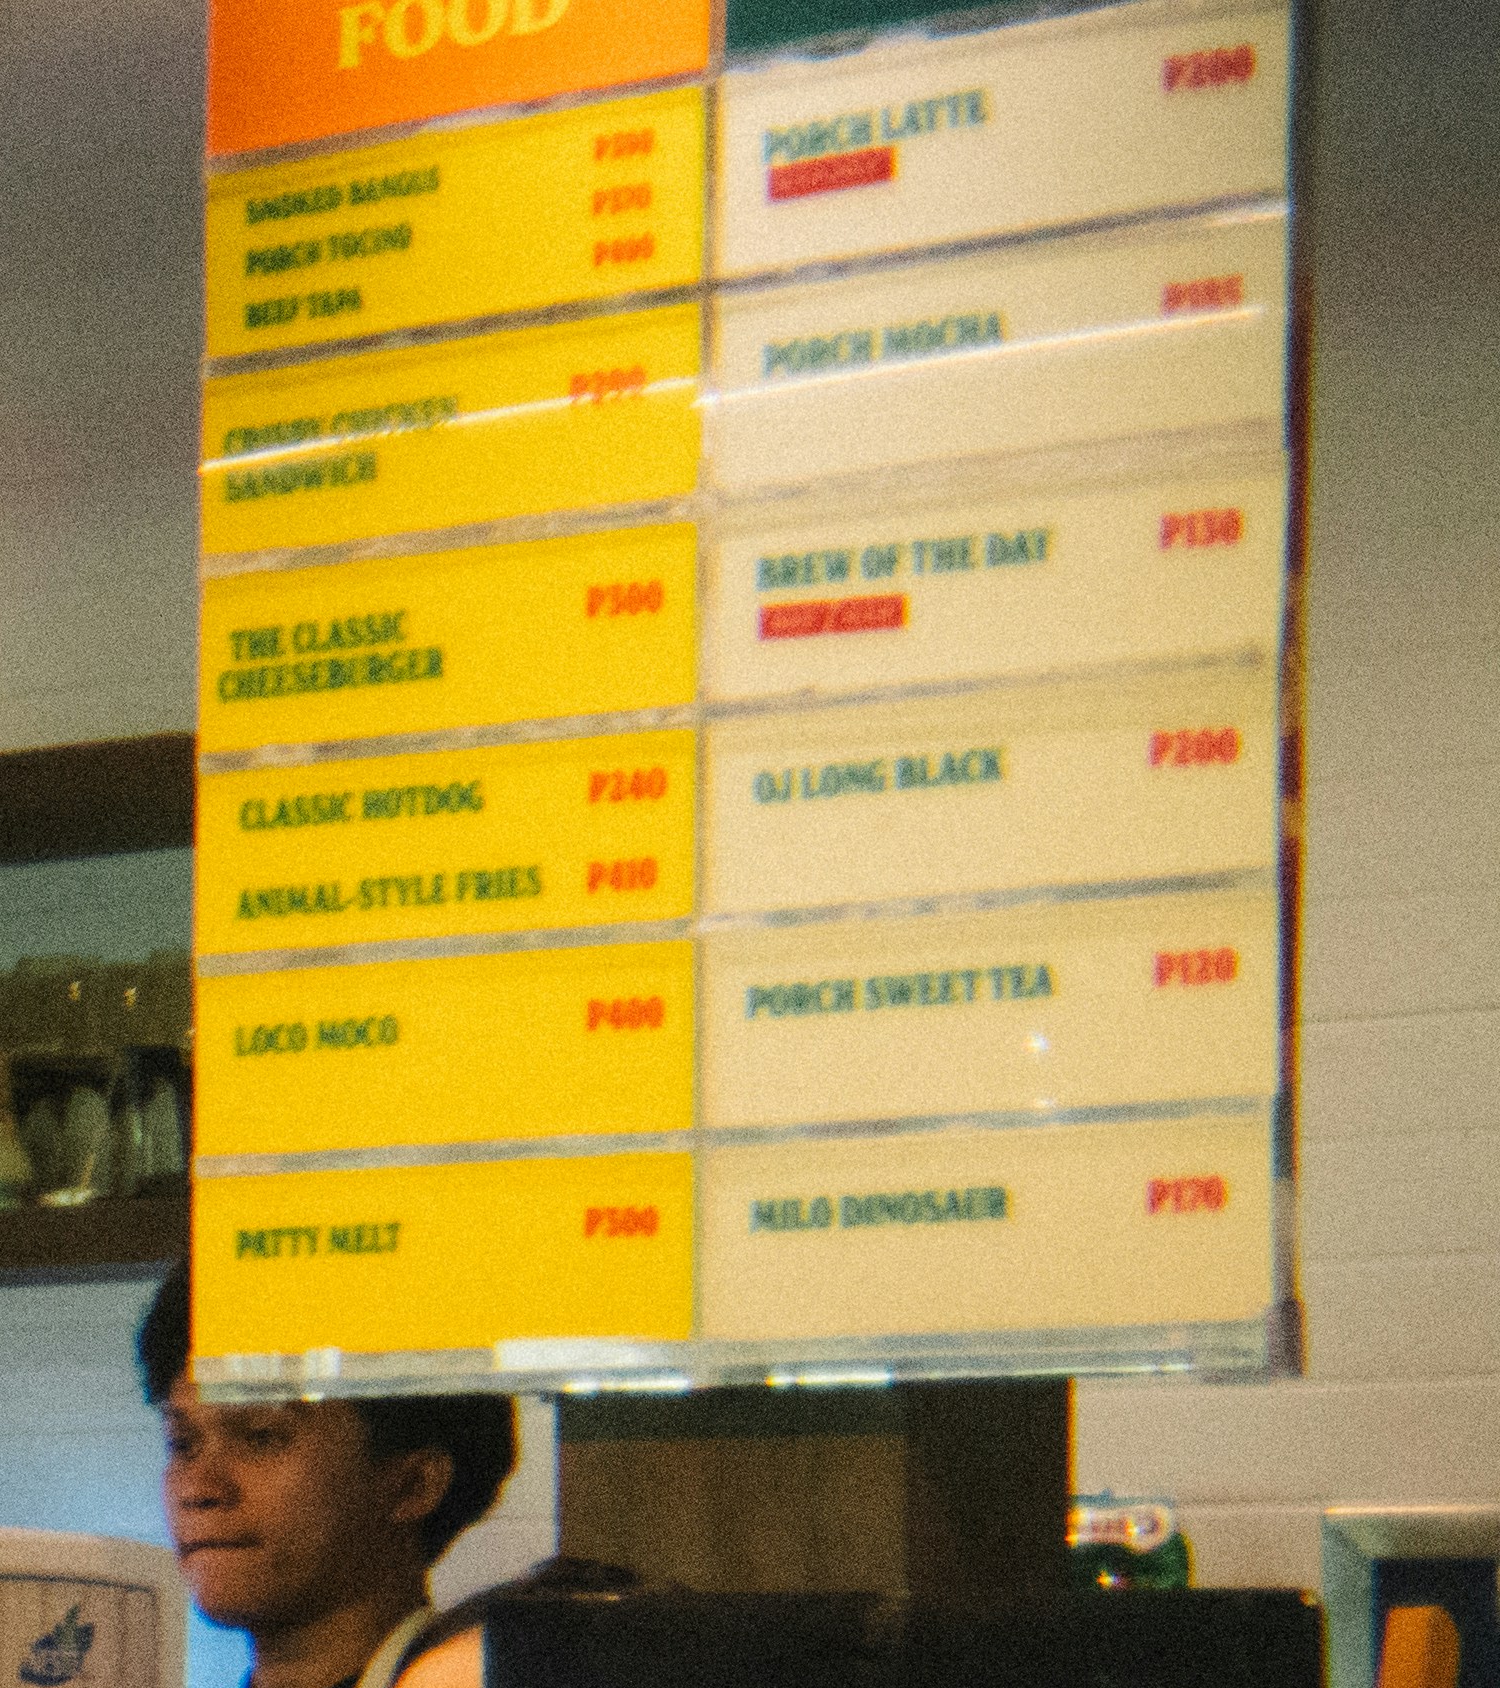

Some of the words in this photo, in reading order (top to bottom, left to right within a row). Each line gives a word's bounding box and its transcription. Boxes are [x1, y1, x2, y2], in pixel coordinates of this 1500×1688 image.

[338, 0, 570, 69] FOOD
[883, 92, 986, 138] LATTE
[764, 336, 871, 376] PORCH
[886, 315, 1002, 360] MOCHA
[758, 552, 849, 590] BREW
[864, 545, 897, 578] OF
[913, 538, 977, 572] THE
[987, 531, 1050, 566] DAY
[231, 628, 283, 659] THE
[293, 612, 406, 650] CLASSIC
[217, 649, 442, 701] CHEESEBURGER
[754, 772, 790, 802] OJ
[802, 761, 884, 797] LONG
[898, 750, 1001, 789] BLACK
[1150, 730, 1239, 767] P200
[241, 794, 351, 829] CLASSIC
[362, 783, 483, 820] HOTDOG
[236, 874, 445, 919] ANIMAL-STYLE
[457, 867, 542, 899] FRIES
[747, 986, 853, 1018] PORCH
[866, 972, 978, 1008] SWEET
[990, 967, 1053, 1000] TEA
[1155, 951, 1237, 985] P120
[235, 1024, 306, 1055] LOCO
[317, 1017, 399, 1048] MOCO
[752, 1198, 831, 1231] MILO
[842, 1188, 1007, 1227] DINOSAUR
[236, 1228, 319, 1259] PATTY
[329, 1223, 400, 1252] MELT
